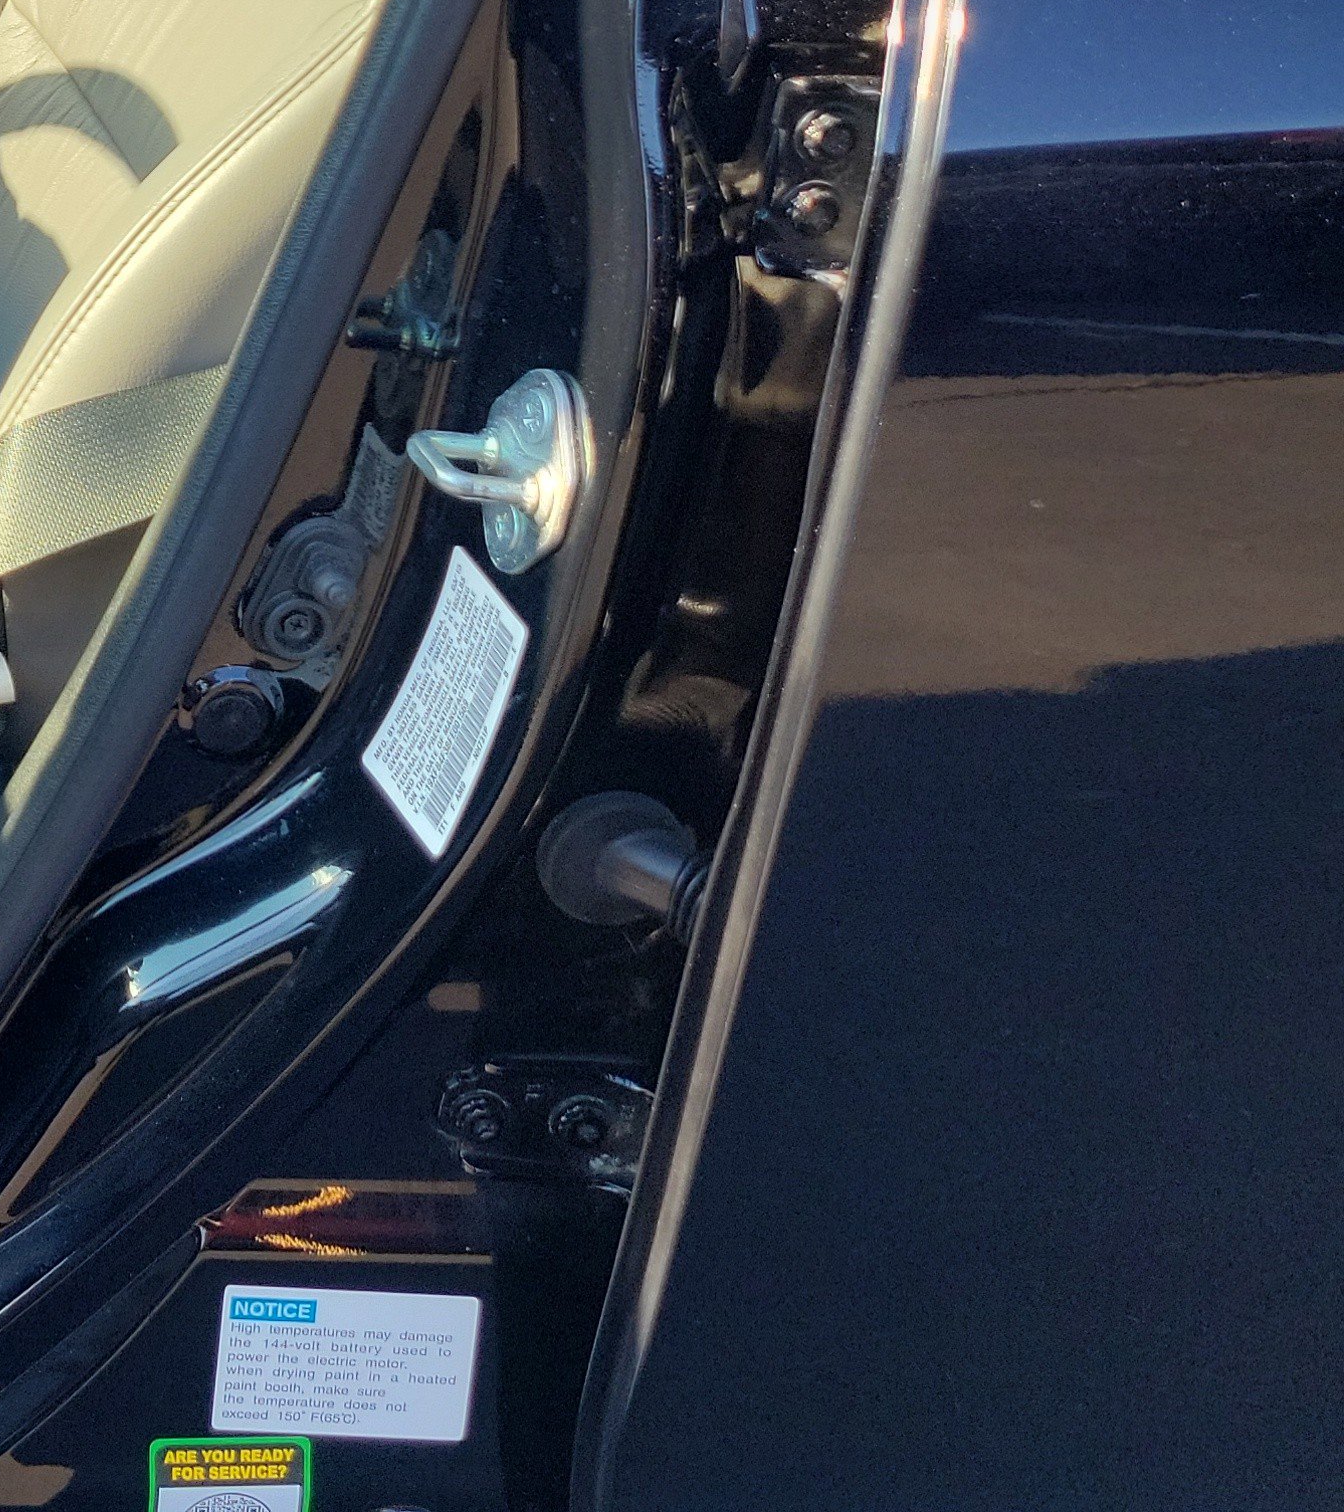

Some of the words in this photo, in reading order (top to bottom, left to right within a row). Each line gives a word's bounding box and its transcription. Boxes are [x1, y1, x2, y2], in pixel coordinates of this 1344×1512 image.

[233, 1299, 311, 1319] NOTICE
[230, 1322, 261, 1335] High
[269, 1324, 356, 1338] temperatures
[364, 1330, 391, 1341] may
[399, 1331, 453, 1343] damage
[229, 1337, 251, 1348] the
[330, 1342, 382, 1356] battery
[392, 1345, 427, 1356] used
[227, 1354, 269, 1364] power
[277, 1353, 299, 1364] the
[307, 1355, 357, 1367] electric
[272, 1367, 315, 1380] drying
[324, 1369, 359, 1382] paint
[409, 1374, 457, 1385] heated
[224, 1381, 257, 1394] paint
[313, 1384, 349, 1395] make
[357, 1388, 386, 1397] sure
[223, 1394, 245, 1404] the
[253, 1394, 335, 1410] temperature
[344, 1399, 377, 1411] does
[385, 1402, 407, 1412] not
[221, 1408, 268, 1420] exceed
[164, 1450, 197, 1464] ARE
[202, 1449, 235, 1463] YOU
[240, 1448, 295, 1462] READY
[171, 1467, 205, 1481] FOR
[209, 1465, 288, 1480] SERVICE?
